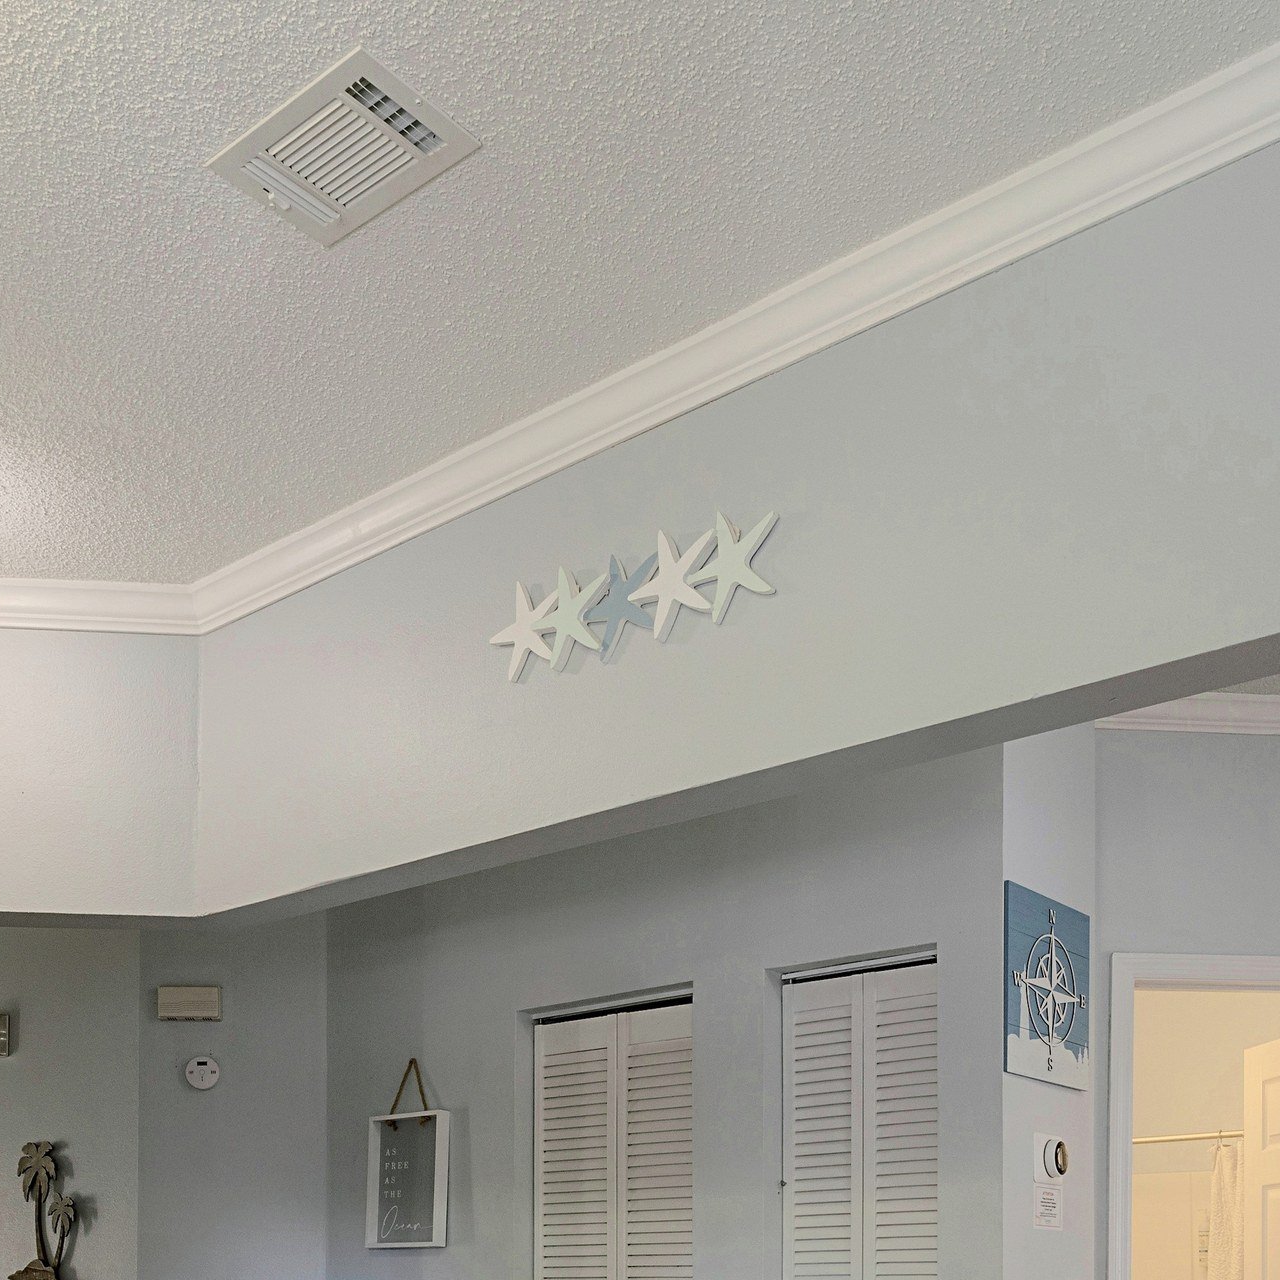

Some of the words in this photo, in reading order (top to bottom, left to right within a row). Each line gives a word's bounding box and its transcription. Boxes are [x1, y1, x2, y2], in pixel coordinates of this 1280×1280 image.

[1048, 908, 1057, 925] N
[1047, 1057, 1054, 1072] S
[385, 1147, 397, 1157] AS
[384, 1161, 409, 1170] FREE
[384, 1176, 396, 1185] AS
[384, 1190, 402, 1199] THE
